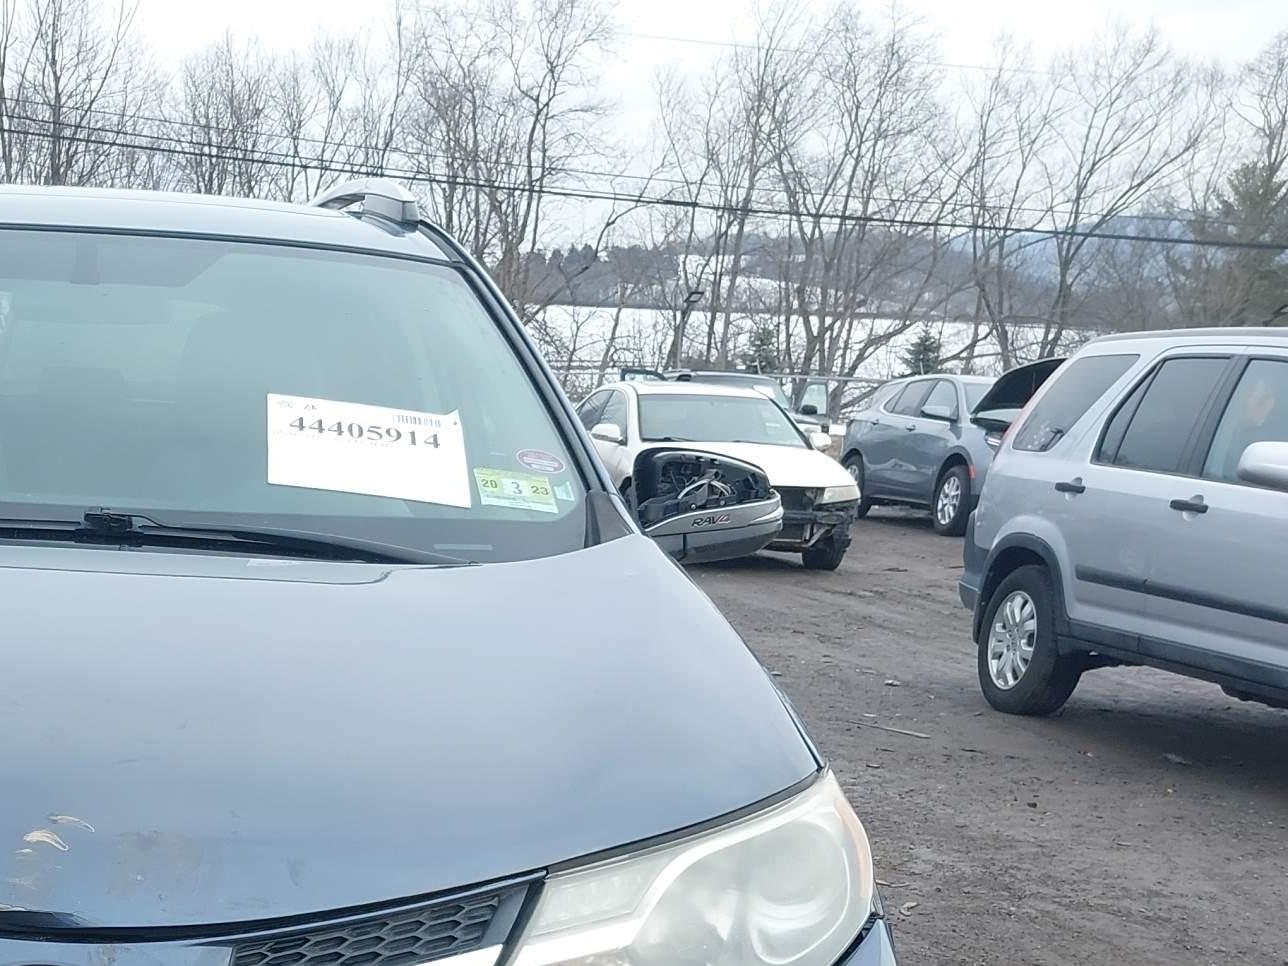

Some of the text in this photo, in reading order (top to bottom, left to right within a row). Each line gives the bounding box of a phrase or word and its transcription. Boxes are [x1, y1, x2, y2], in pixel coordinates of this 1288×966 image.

[289, 416, 441, 449] 44405914
[480, 478, 549, 496] 20 3 23
[691, 513, 730, 527] RAV4
